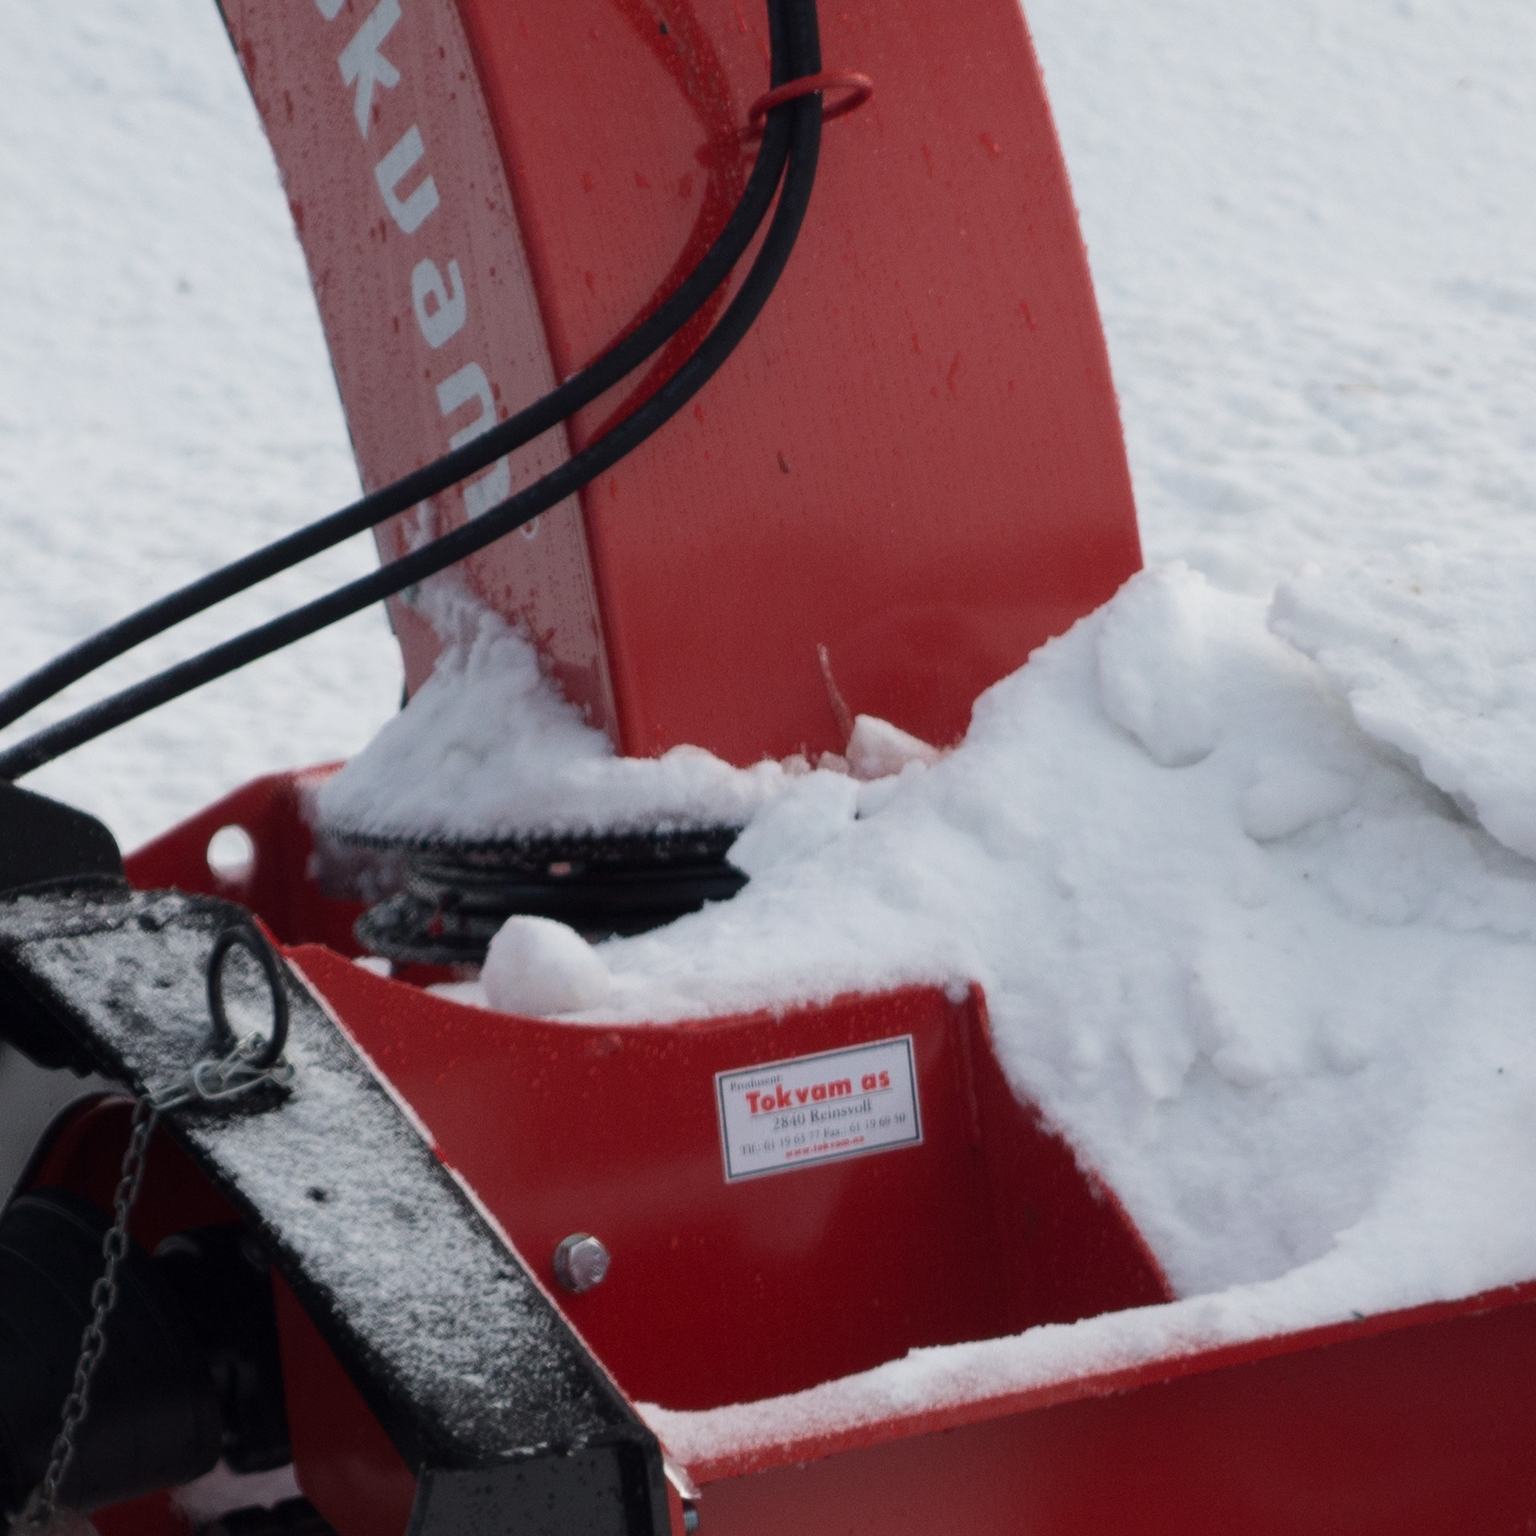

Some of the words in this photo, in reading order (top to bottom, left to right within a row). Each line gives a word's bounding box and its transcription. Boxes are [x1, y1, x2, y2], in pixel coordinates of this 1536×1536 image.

[314, 0, 511, 520] kvam
[745, 1077, 852, 1115] Tokvam
[861, 1070, 890, 1091] as
[773, 1111, 805, 1131] 2840
[810, 1098, 871, 1123] Reinsvoll
